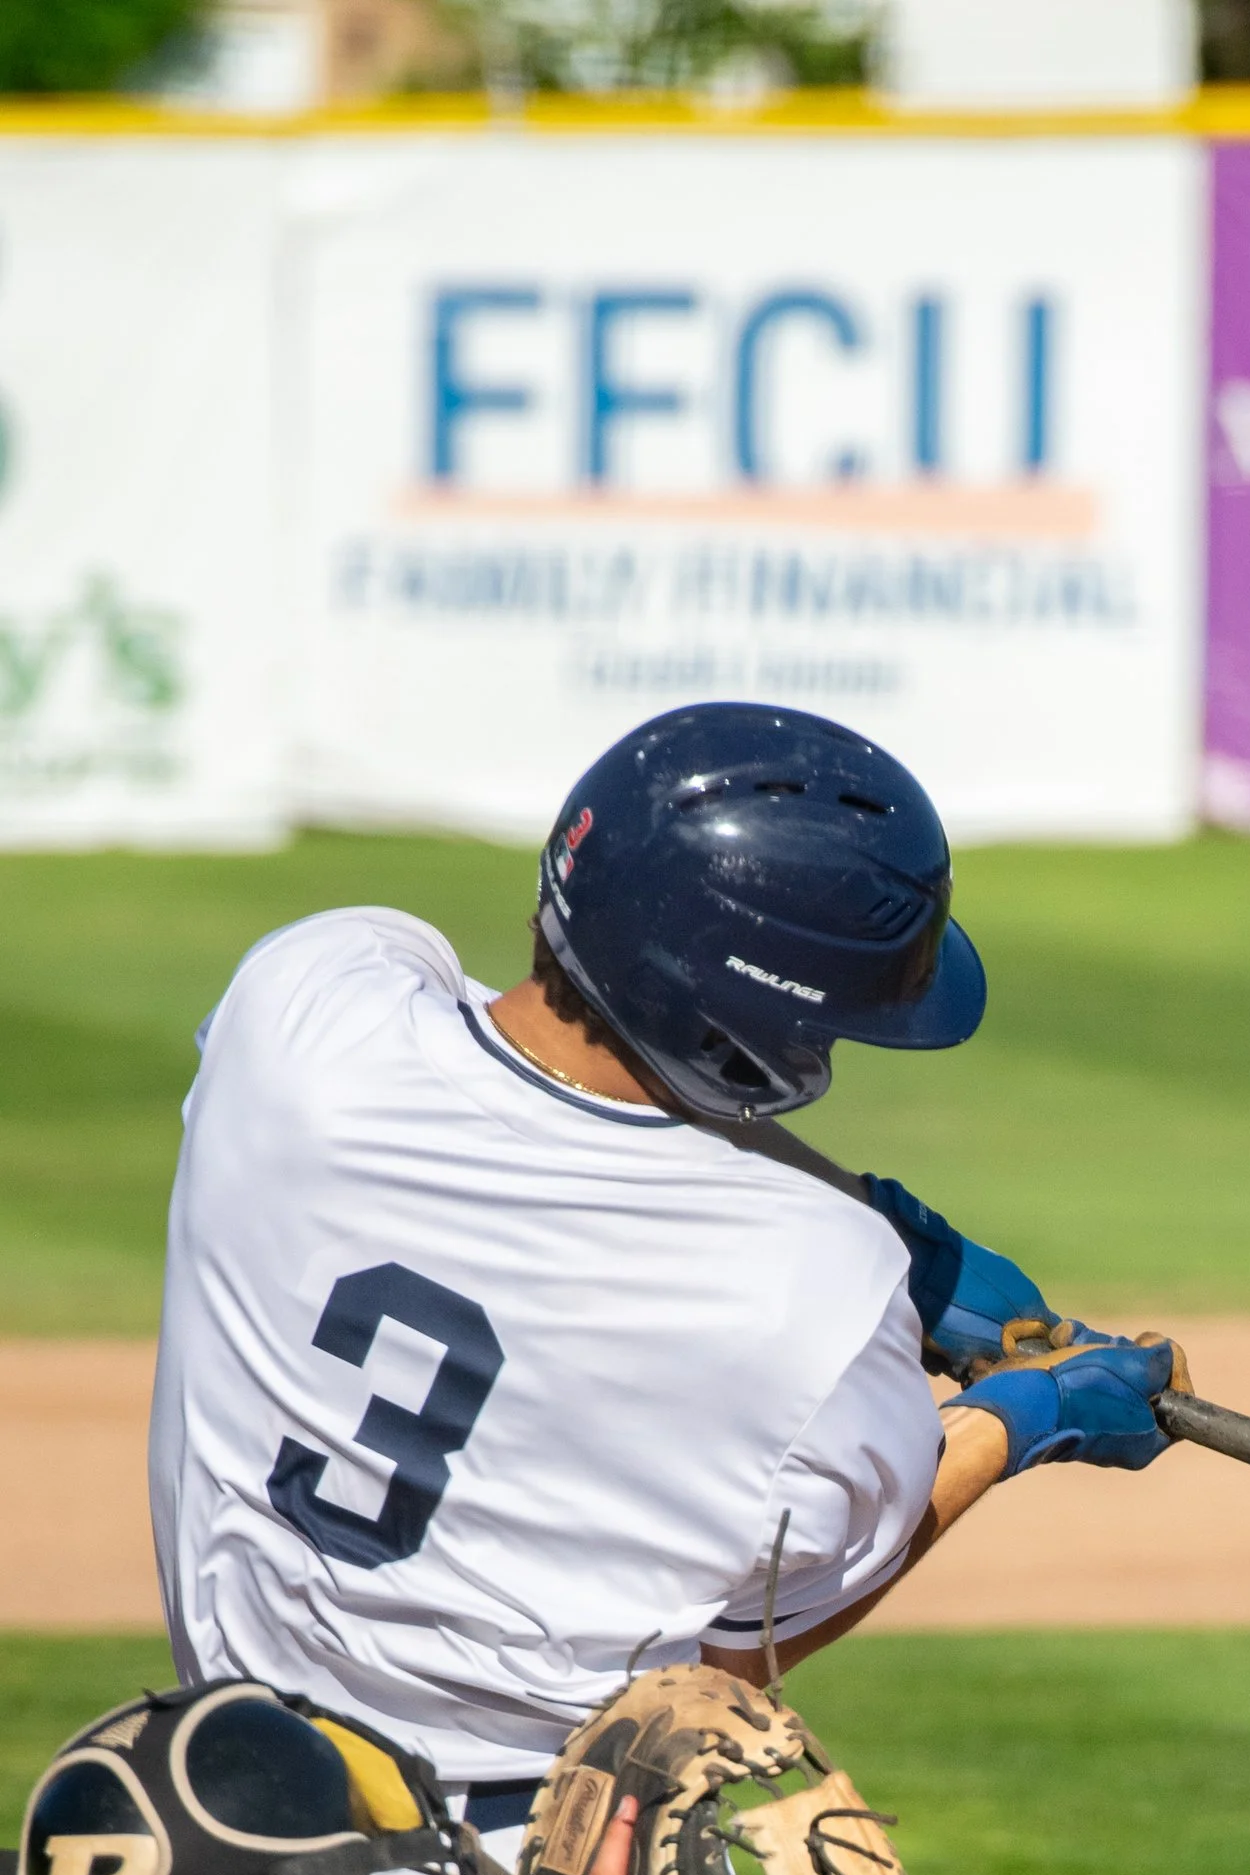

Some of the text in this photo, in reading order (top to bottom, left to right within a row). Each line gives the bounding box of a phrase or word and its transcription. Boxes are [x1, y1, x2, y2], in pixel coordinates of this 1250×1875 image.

[426, 282, 1058, 488] FFCU
[674, 543, 1138, 624] FINANCIAL
[725, 955, 826, 1004] RAWLINGS
[266, 1261, 505, 1570] 3
